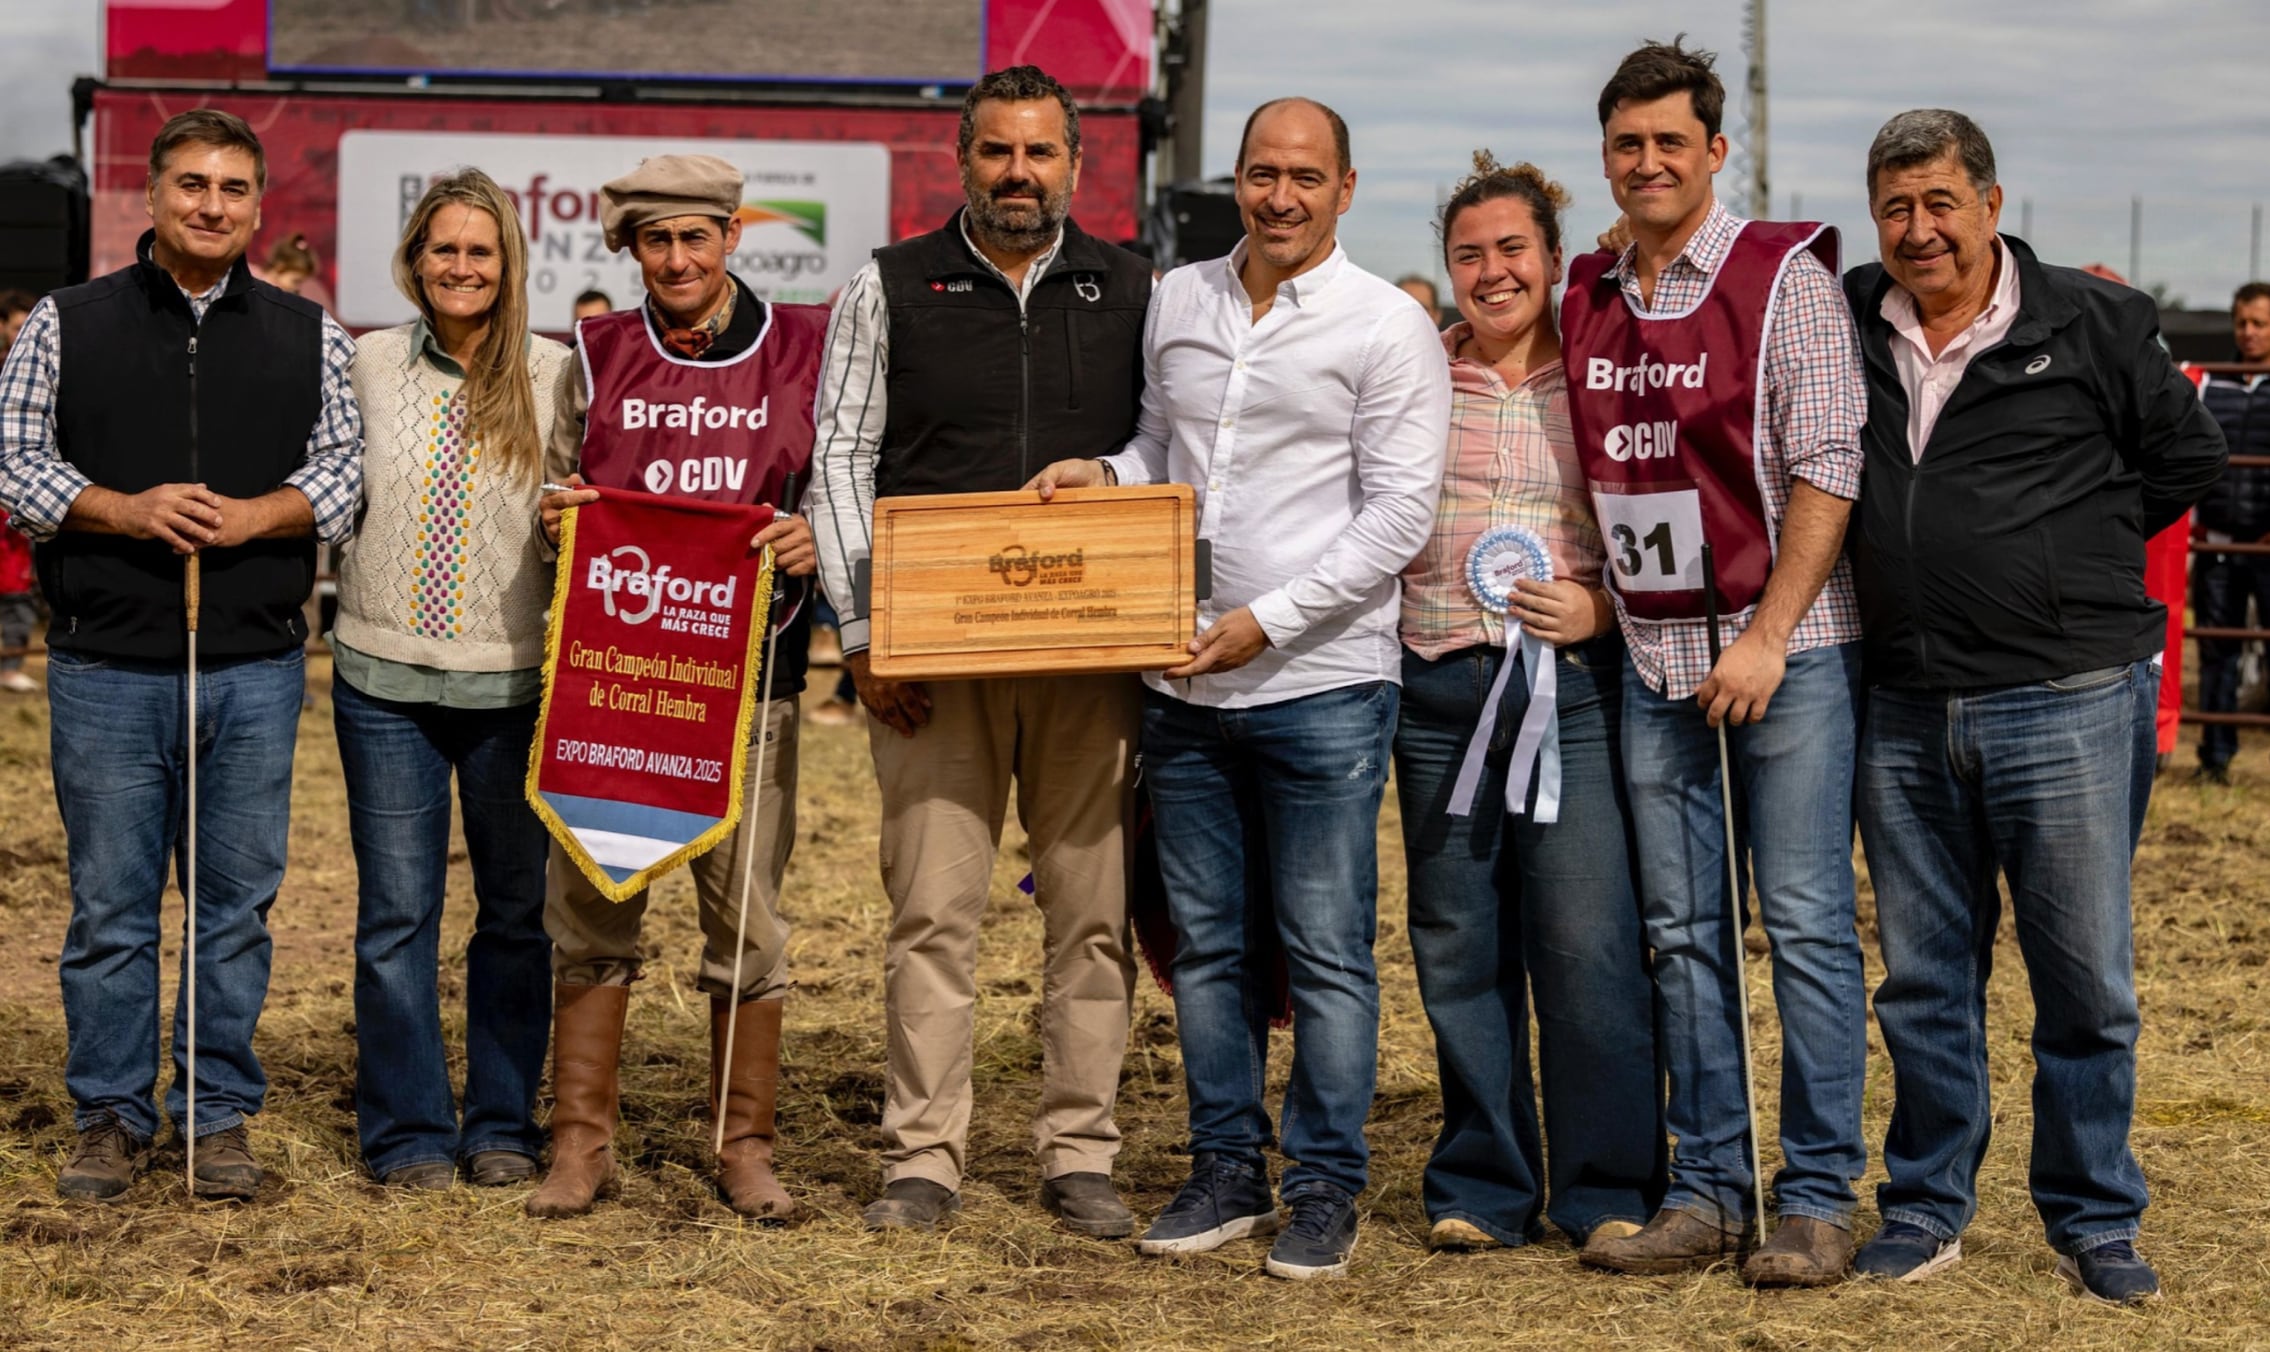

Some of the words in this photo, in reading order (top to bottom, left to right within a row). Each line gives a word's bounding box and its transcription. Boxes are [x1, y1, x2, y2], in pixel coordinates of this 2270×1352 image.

[1586, 352, 1708, 397] Braford
[622, 395, 769, 436] Braford
[1634, 420, 1678, 460] CDV
[679, 456, 748, 493] CDV
[989, 547, 1083, 578] Braford
[1611, 522, 1677, 577] 31
[586, 556, 737, 613] Braford
[661, 616, 688, 632] MÁS
[691, 622, 730, 639] CRECE
[663, 605, 676, 617] LA
[679, 608, 707, 621] RAZA
[709, 613, 731, 625] QUE
[569, 640, 602, 671] Gran
[605, 645, 668, 681] Campeón
[670, 655, 738, 690] Individual
[589, 681, 604, 708] de
[609, 683, 653, 714] Corral
[655, 689, 707, 723] Hembra
[556, 738, 587, 762] EXPO
[588, 743, 645, 772] BRAFORD
[645, 751, 693, 779] AVANZA
[693, 758, 723, 783] 2025
